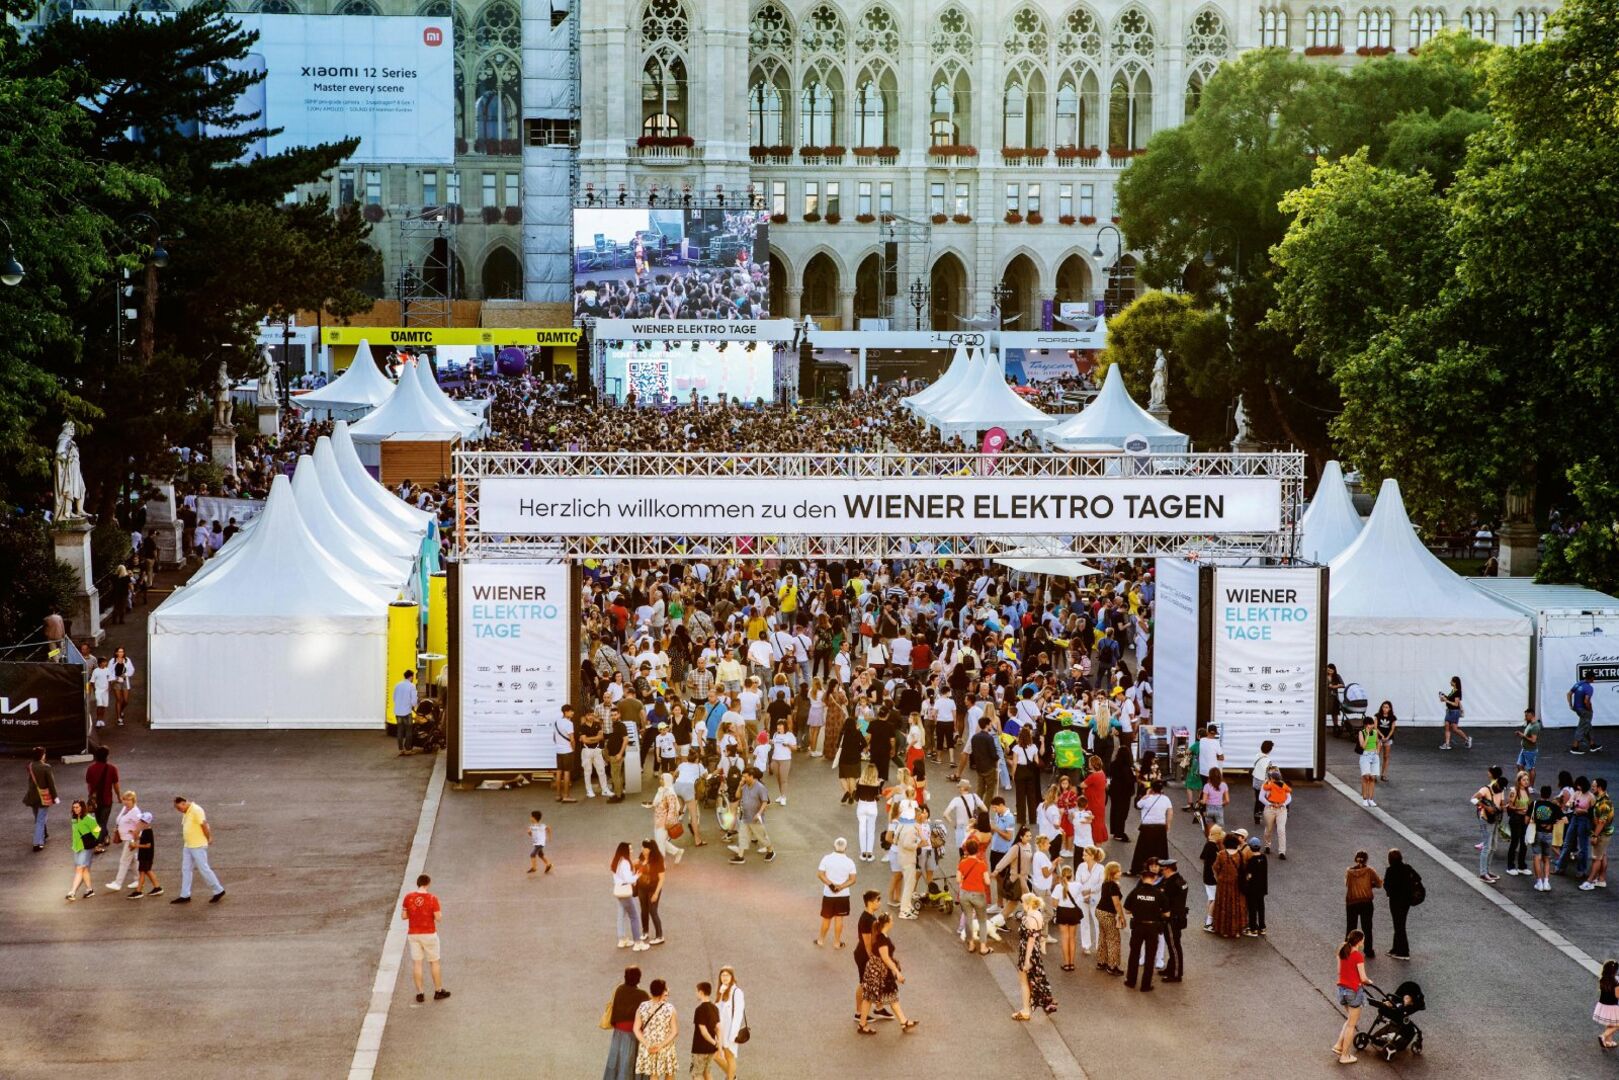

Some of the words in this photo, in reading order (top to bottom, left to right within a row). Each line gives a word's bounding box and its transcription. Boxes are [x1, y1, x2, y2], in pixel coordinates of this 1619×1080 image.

[363, 67, 377, 78] 12
[382, 67, 418, 78] Series
[313, 83, 346, 92] Master
[348, 84, 375, 94] every
[377, 85, 405, 93] scene
[390, 330, 433, 343] ÖAMTC
[632, 324, 675, 334] WIENER
[677, 324, 726, 334] ELEKTRO
[729, 324, 757, 334] TAGE
[536, 330, 579, 344] ÖAMTC
[519, 498, 610, 518] Herzlich
[617, 498, 755, 519] willkommen
[761, 502, 787, 519] zu
[793, 499, 837, 519] den
[843, 494, 965, 519] WIENER
[974, 494, 1114, 519] ELEKTRO
[1123, 494, 1225, 519] TAGEN
[472, 585, 546, 601] WIENER
[1226, 588, 1297, 604] WIENER
[472, 604, 558, 620] ELEKTRO
[1225, 607, 1309, 622] ELEKTRO
[472, 623, 521, 638] TAGE
[1225, 625, 1272, 641] TAGE
